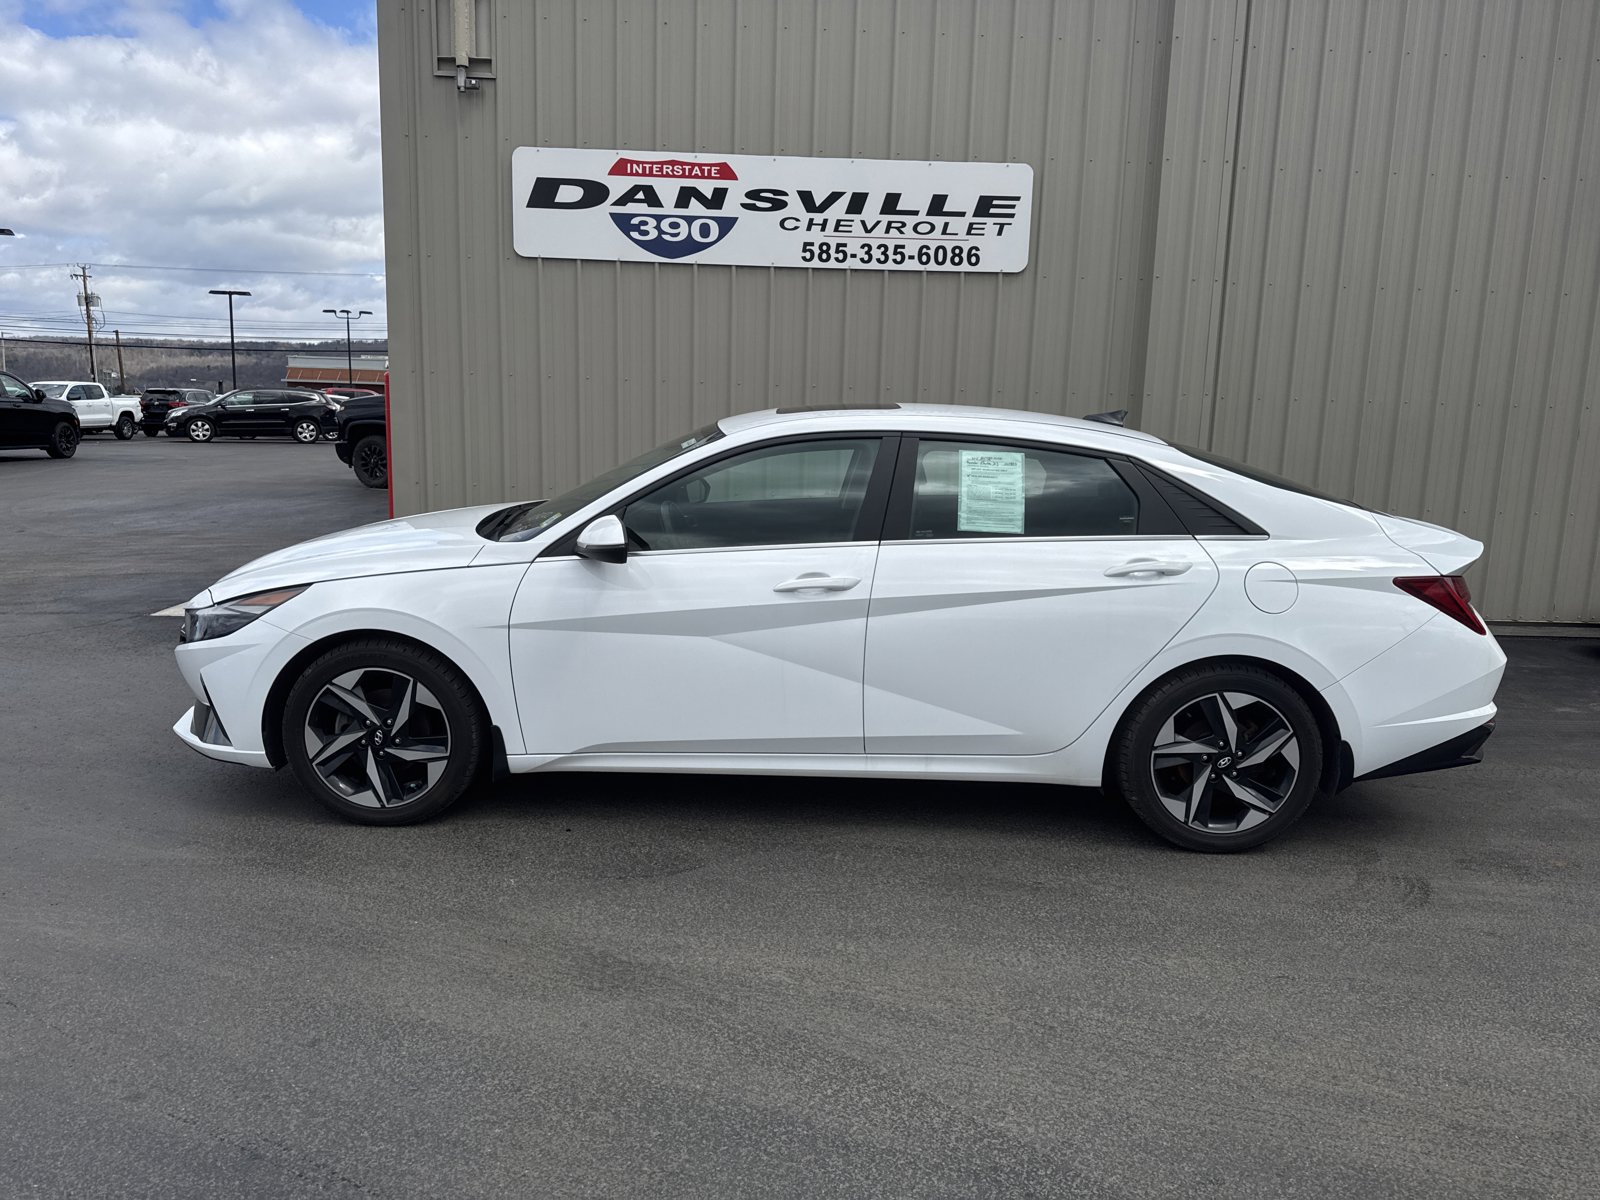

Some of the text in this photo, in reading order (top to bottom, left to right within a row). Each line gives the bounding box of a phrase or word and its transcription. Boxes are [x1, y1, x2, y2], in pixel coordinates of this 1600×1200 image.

[627, 163, 720, 177] INTERSTATE
[526, 176, 1021, 219] DANSVILLE
[630, 216, 719, 243] 390
[779, 216, 1012, 237] CHEVROLET
[801, 241, 981, 267] 585-335-6086
